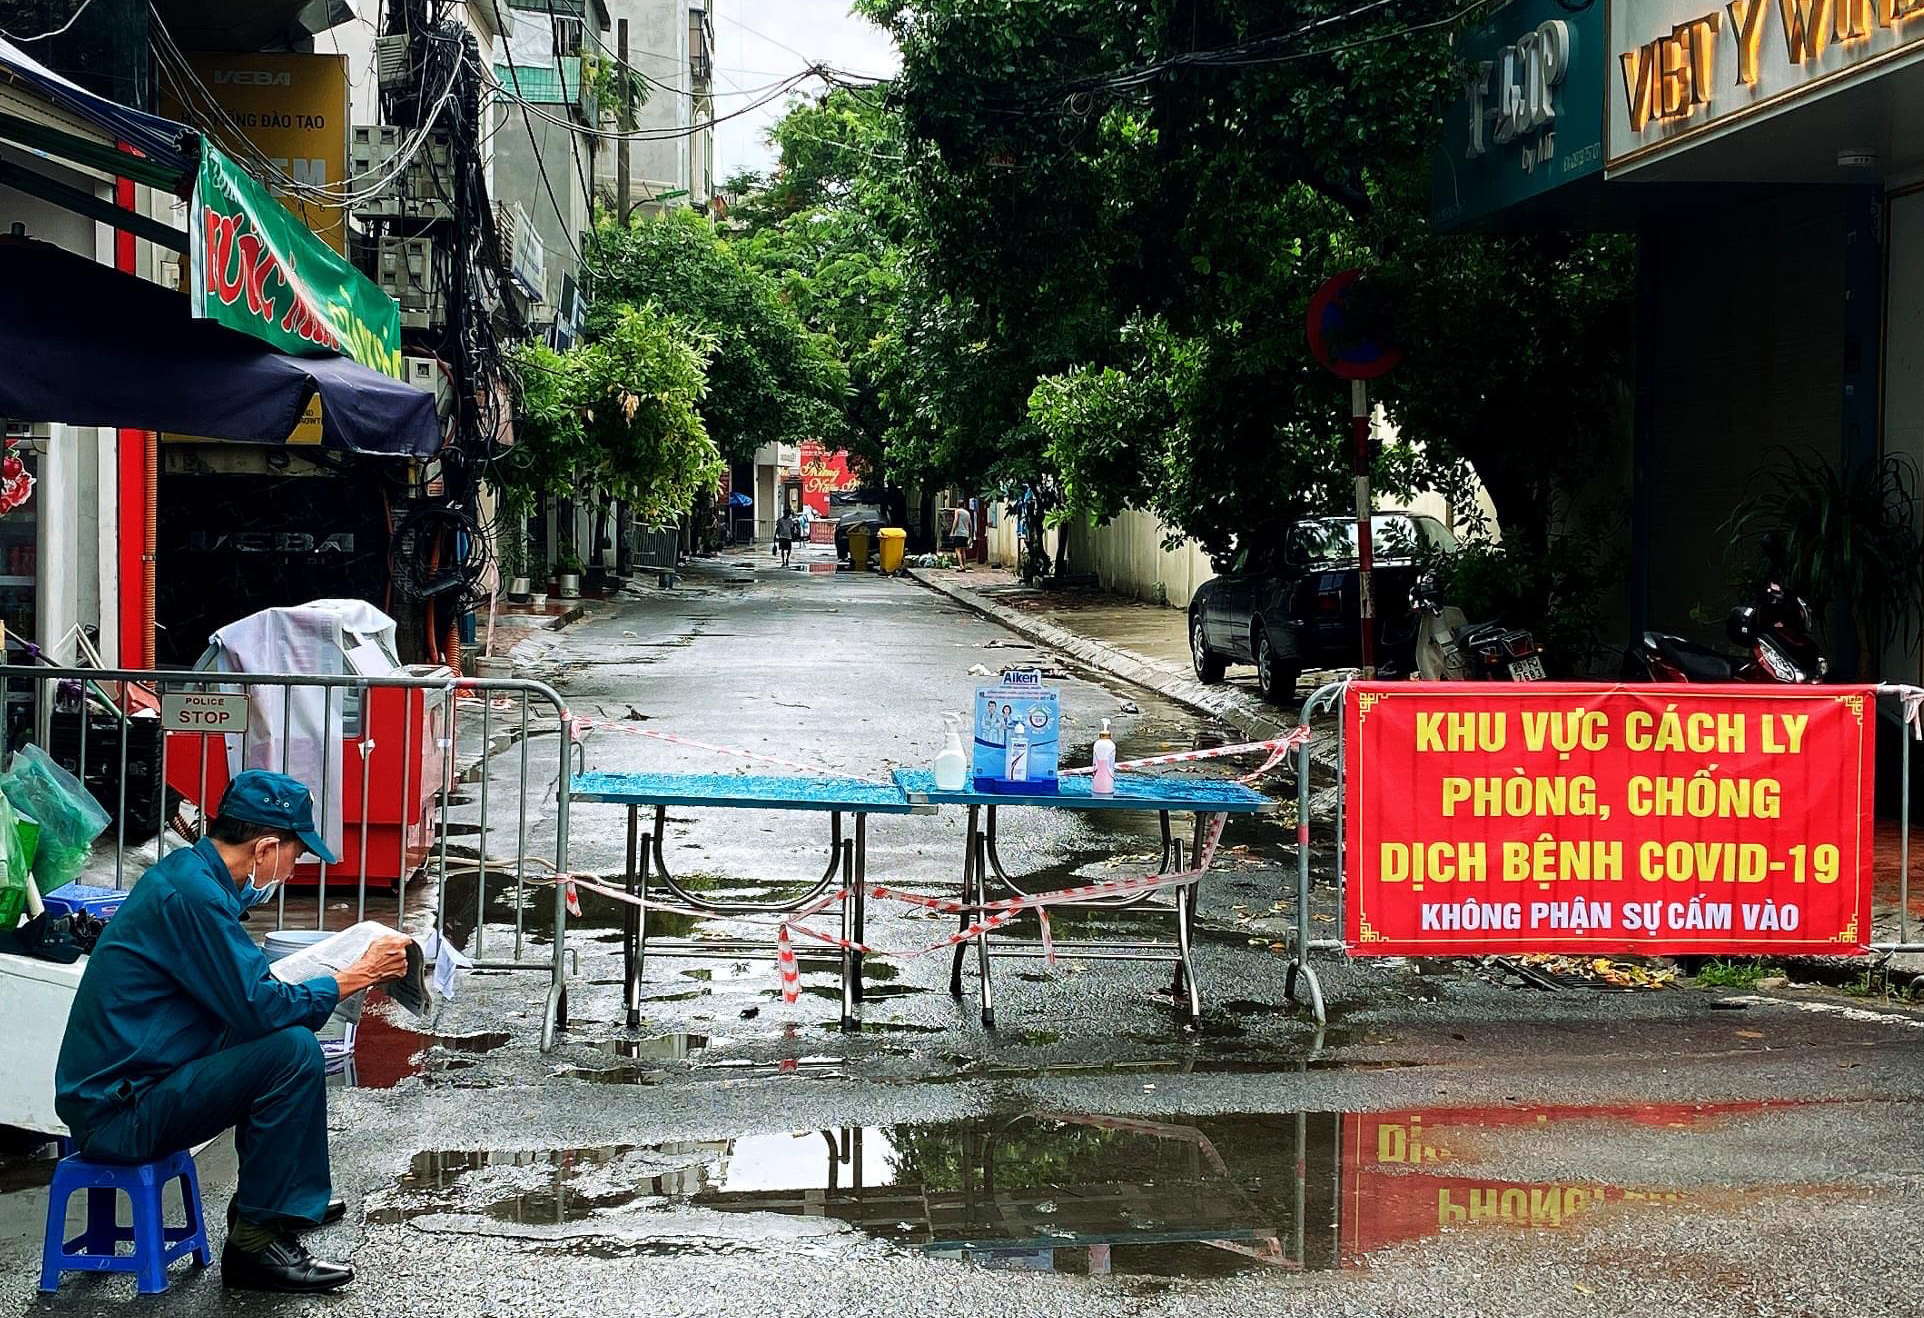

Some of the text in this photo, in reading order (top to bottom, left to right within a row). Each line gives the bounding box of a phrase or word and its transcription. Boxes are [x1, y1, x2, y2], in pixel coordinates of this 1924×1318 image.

[213, 70, 291, 86] VEBA
[261, 110, 292, 128] ĐÀO
[296, 114, 325, 132] TẠO
[179, 710, 230, 724] STOP
[185, 697, 225, 706] POLICE
[1416, 703, 1809, 761] KHU VỰC CÁCH LY
[1442, 763, 1781, 821] PHÒNG, CHỐNG
[1380, 832, 1840, 891] DỊCH BỆNH COVID-19
[1421, 893, 1799, 937] KHÔNG PHẬN SỰ CẤM VÀO
